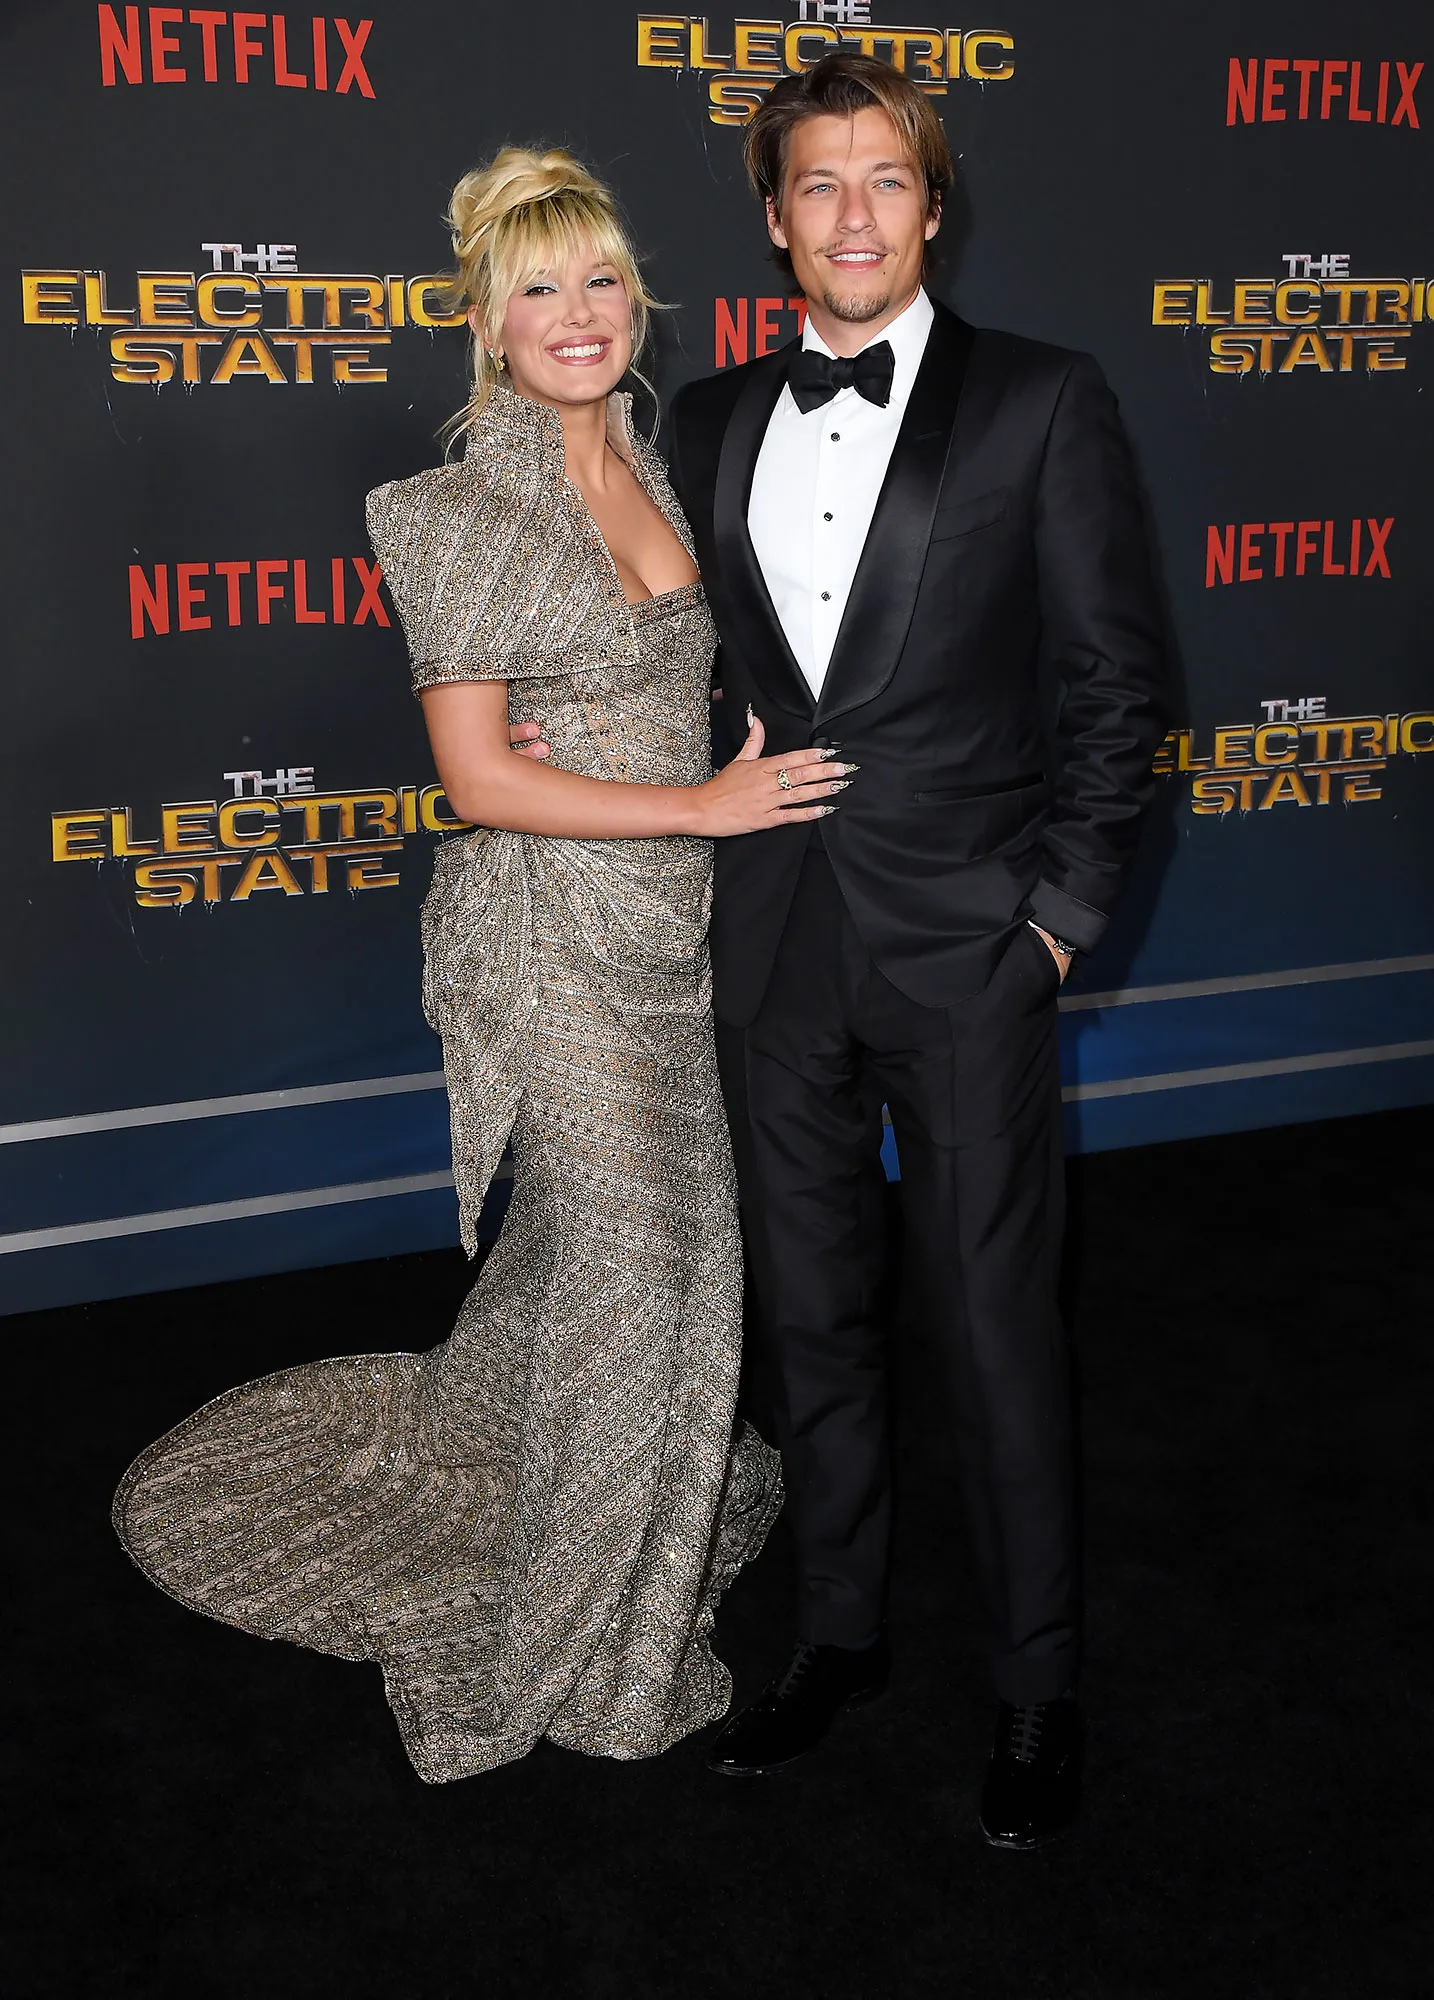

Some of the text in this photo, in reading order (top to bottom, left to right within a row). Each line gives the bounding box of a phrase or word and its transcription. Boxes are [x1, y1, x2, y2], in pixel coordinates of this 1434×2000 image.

[790, 0, 871, 24] THE
[97, 4, 376, 99] NETFLIX
[637, 13, 1015, 81] ELECTRIC
[1226, 57, 1425, 129] NETFLIX
[201, 242, 298, 272] THE
[1282, 254, 1350, 278] THE
[20, 269, 468, 330] ELECTRIC
[1152, 277, 1434, 326] ELECTRI
[110, 328, 392, 384] STATE
[1209, 324, 1412, 374] STATE
[1205, 517, 1395, 588] NETFLIX
[128, 556, 392, 640] NETFLIX
[1260, 696, 1327, 722] THE
[223, 766, 315, 797] THE
[1191, 757, 1387, 815] STATE
[51, 782, 475, 863] ELECTRIC
[134, 836, 404, 908] STATE
